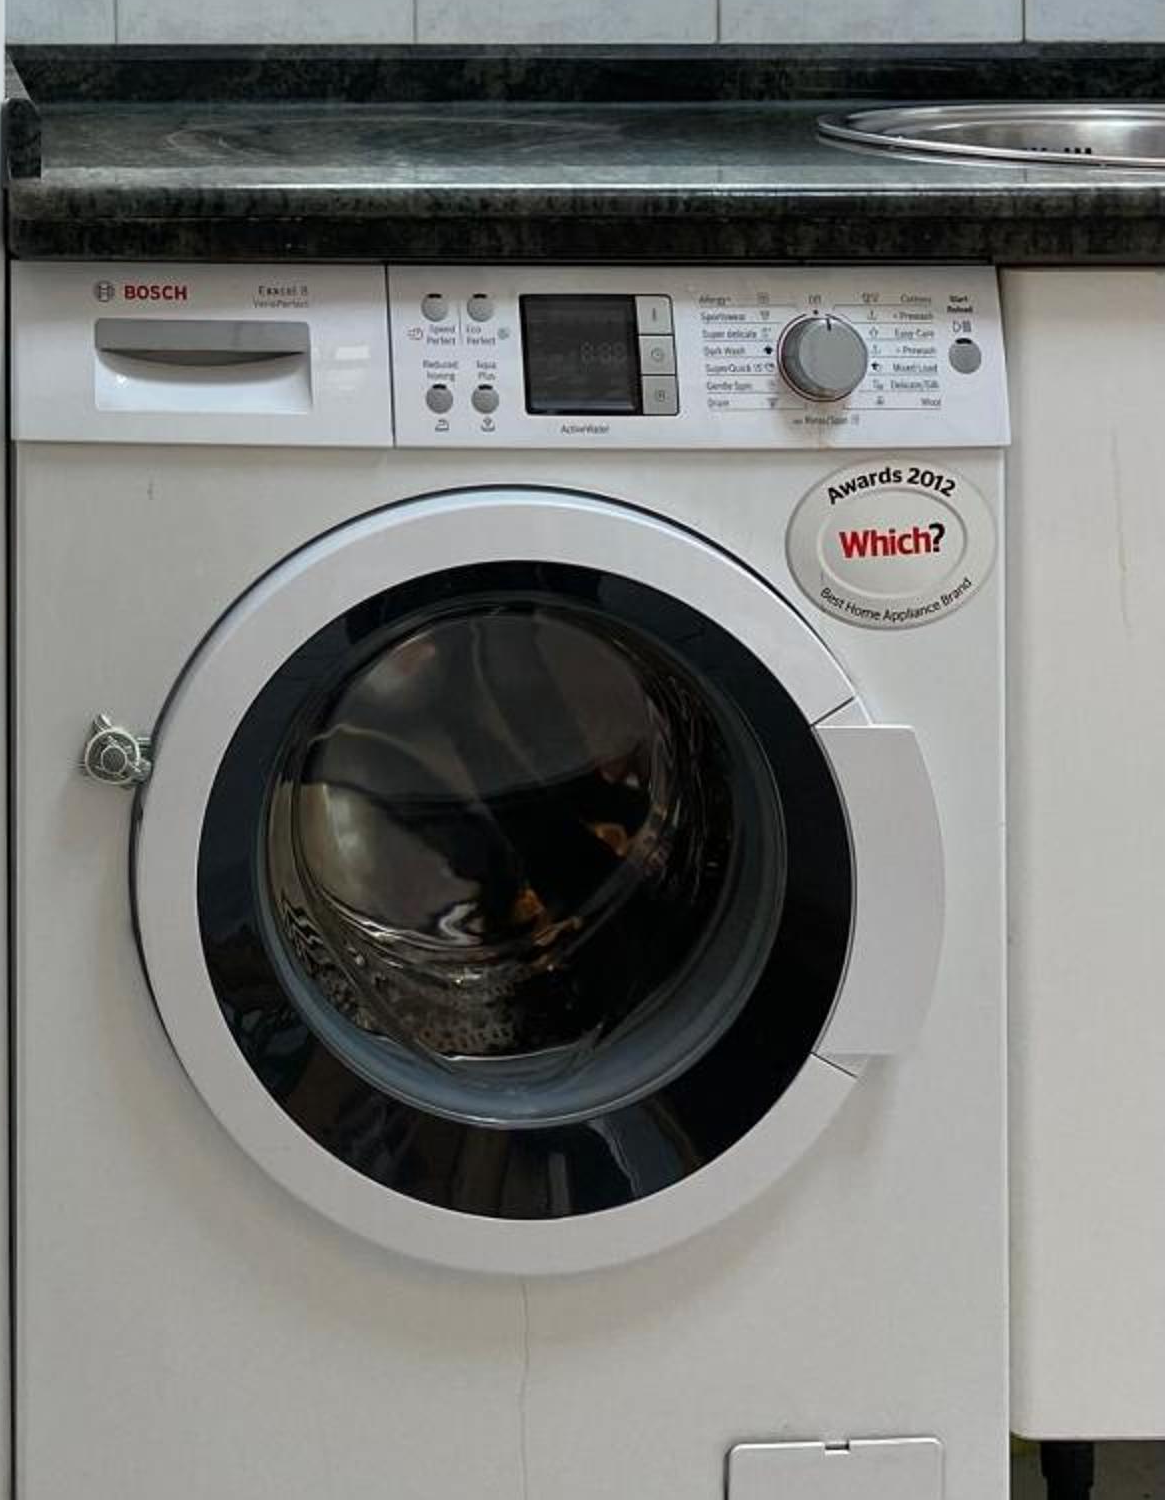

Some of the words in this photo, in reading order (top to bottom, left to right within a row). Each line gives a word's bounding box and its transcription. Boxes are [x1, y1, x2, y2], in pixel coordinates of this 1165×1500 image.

[123, 285, 188, 301] BOSCH
[949, 295, 968, 304] Start
[700, 312, 746, 323] Sportswear
[429, 325, 455, 337] Speed
[466, 325, 482, 334] Eco
[702, 329, 727, 339] Super
[894, 328, 914, 339] Easy
[915, 329, 935, 338] Care
[426, 336, 456, 346] Perfect
[466, 336, 496, 346] Perfect
[704, 346, 722, 355] Dark
[724, 346, 746, 355] Wash
[422, 359, 459, 369] Reduced
[892, 362, 916, 372] Mixed
[919, 362, 938, 372] Load
[707, 381, 732, 390] Gentle
[707, 398, 730, 407] Drain
[921, 397, 941, 406] Wool
[826, 467, 902, 505] Awards
[907, 467, 956, 498] 2012
[838, 523, 946, 558] Which?
[820, 586, 844, 610] Best
[845, 602, 881, 620] Home
[882, 600, 941, 623] Appliance
[941, 577, 972, 609] Brand
